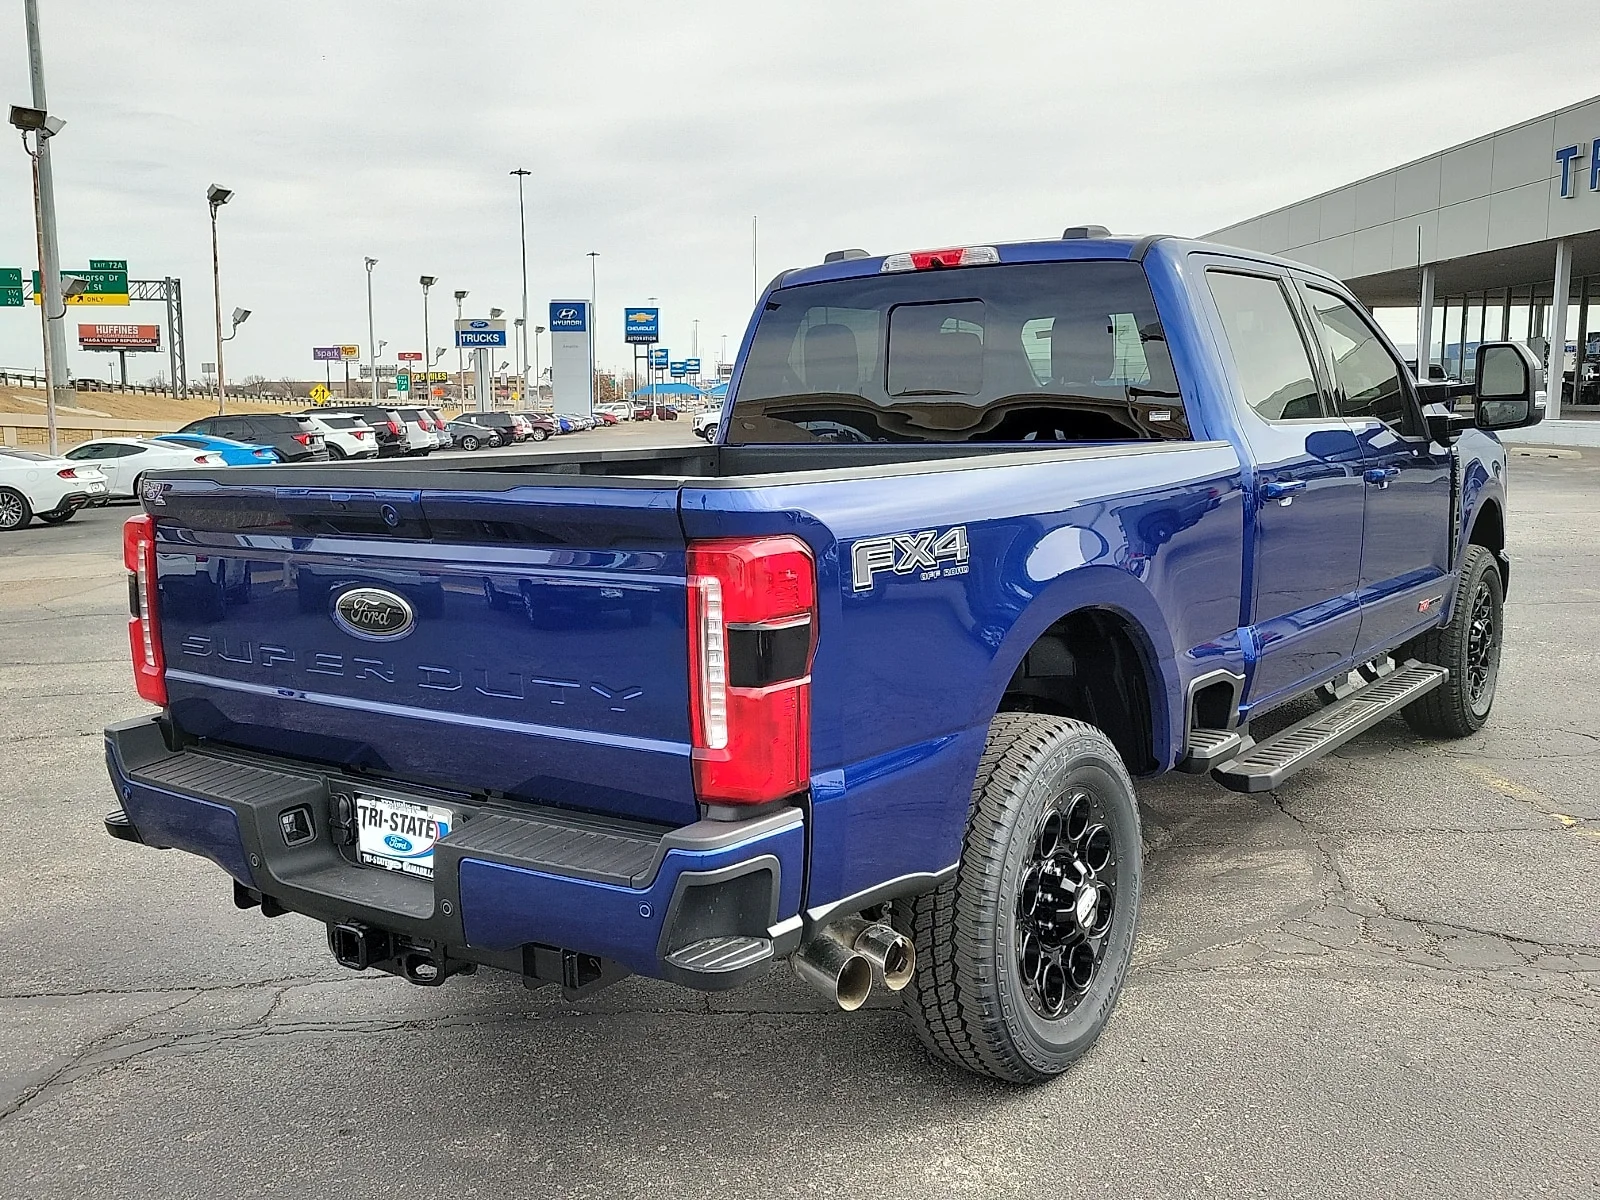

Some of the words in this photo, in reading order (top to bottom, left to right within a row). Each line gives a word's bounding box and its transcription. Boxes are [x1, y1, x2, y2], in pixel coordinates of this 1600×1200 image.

[95, 325, 139, 334] HUFFINES
[461, 333, 500, 343] TRUCKS
[317, 348, 339, 358] spark
[851, 526, 970, 593] FX4
[919, 570, 941, 581] OFF
[350, 598, 392, 627] Ford
[182, 634, 396, 684] SUPER
[417, 664, 644, 713] DUTY
[358, 805, 435, 840] TRI-STATE
